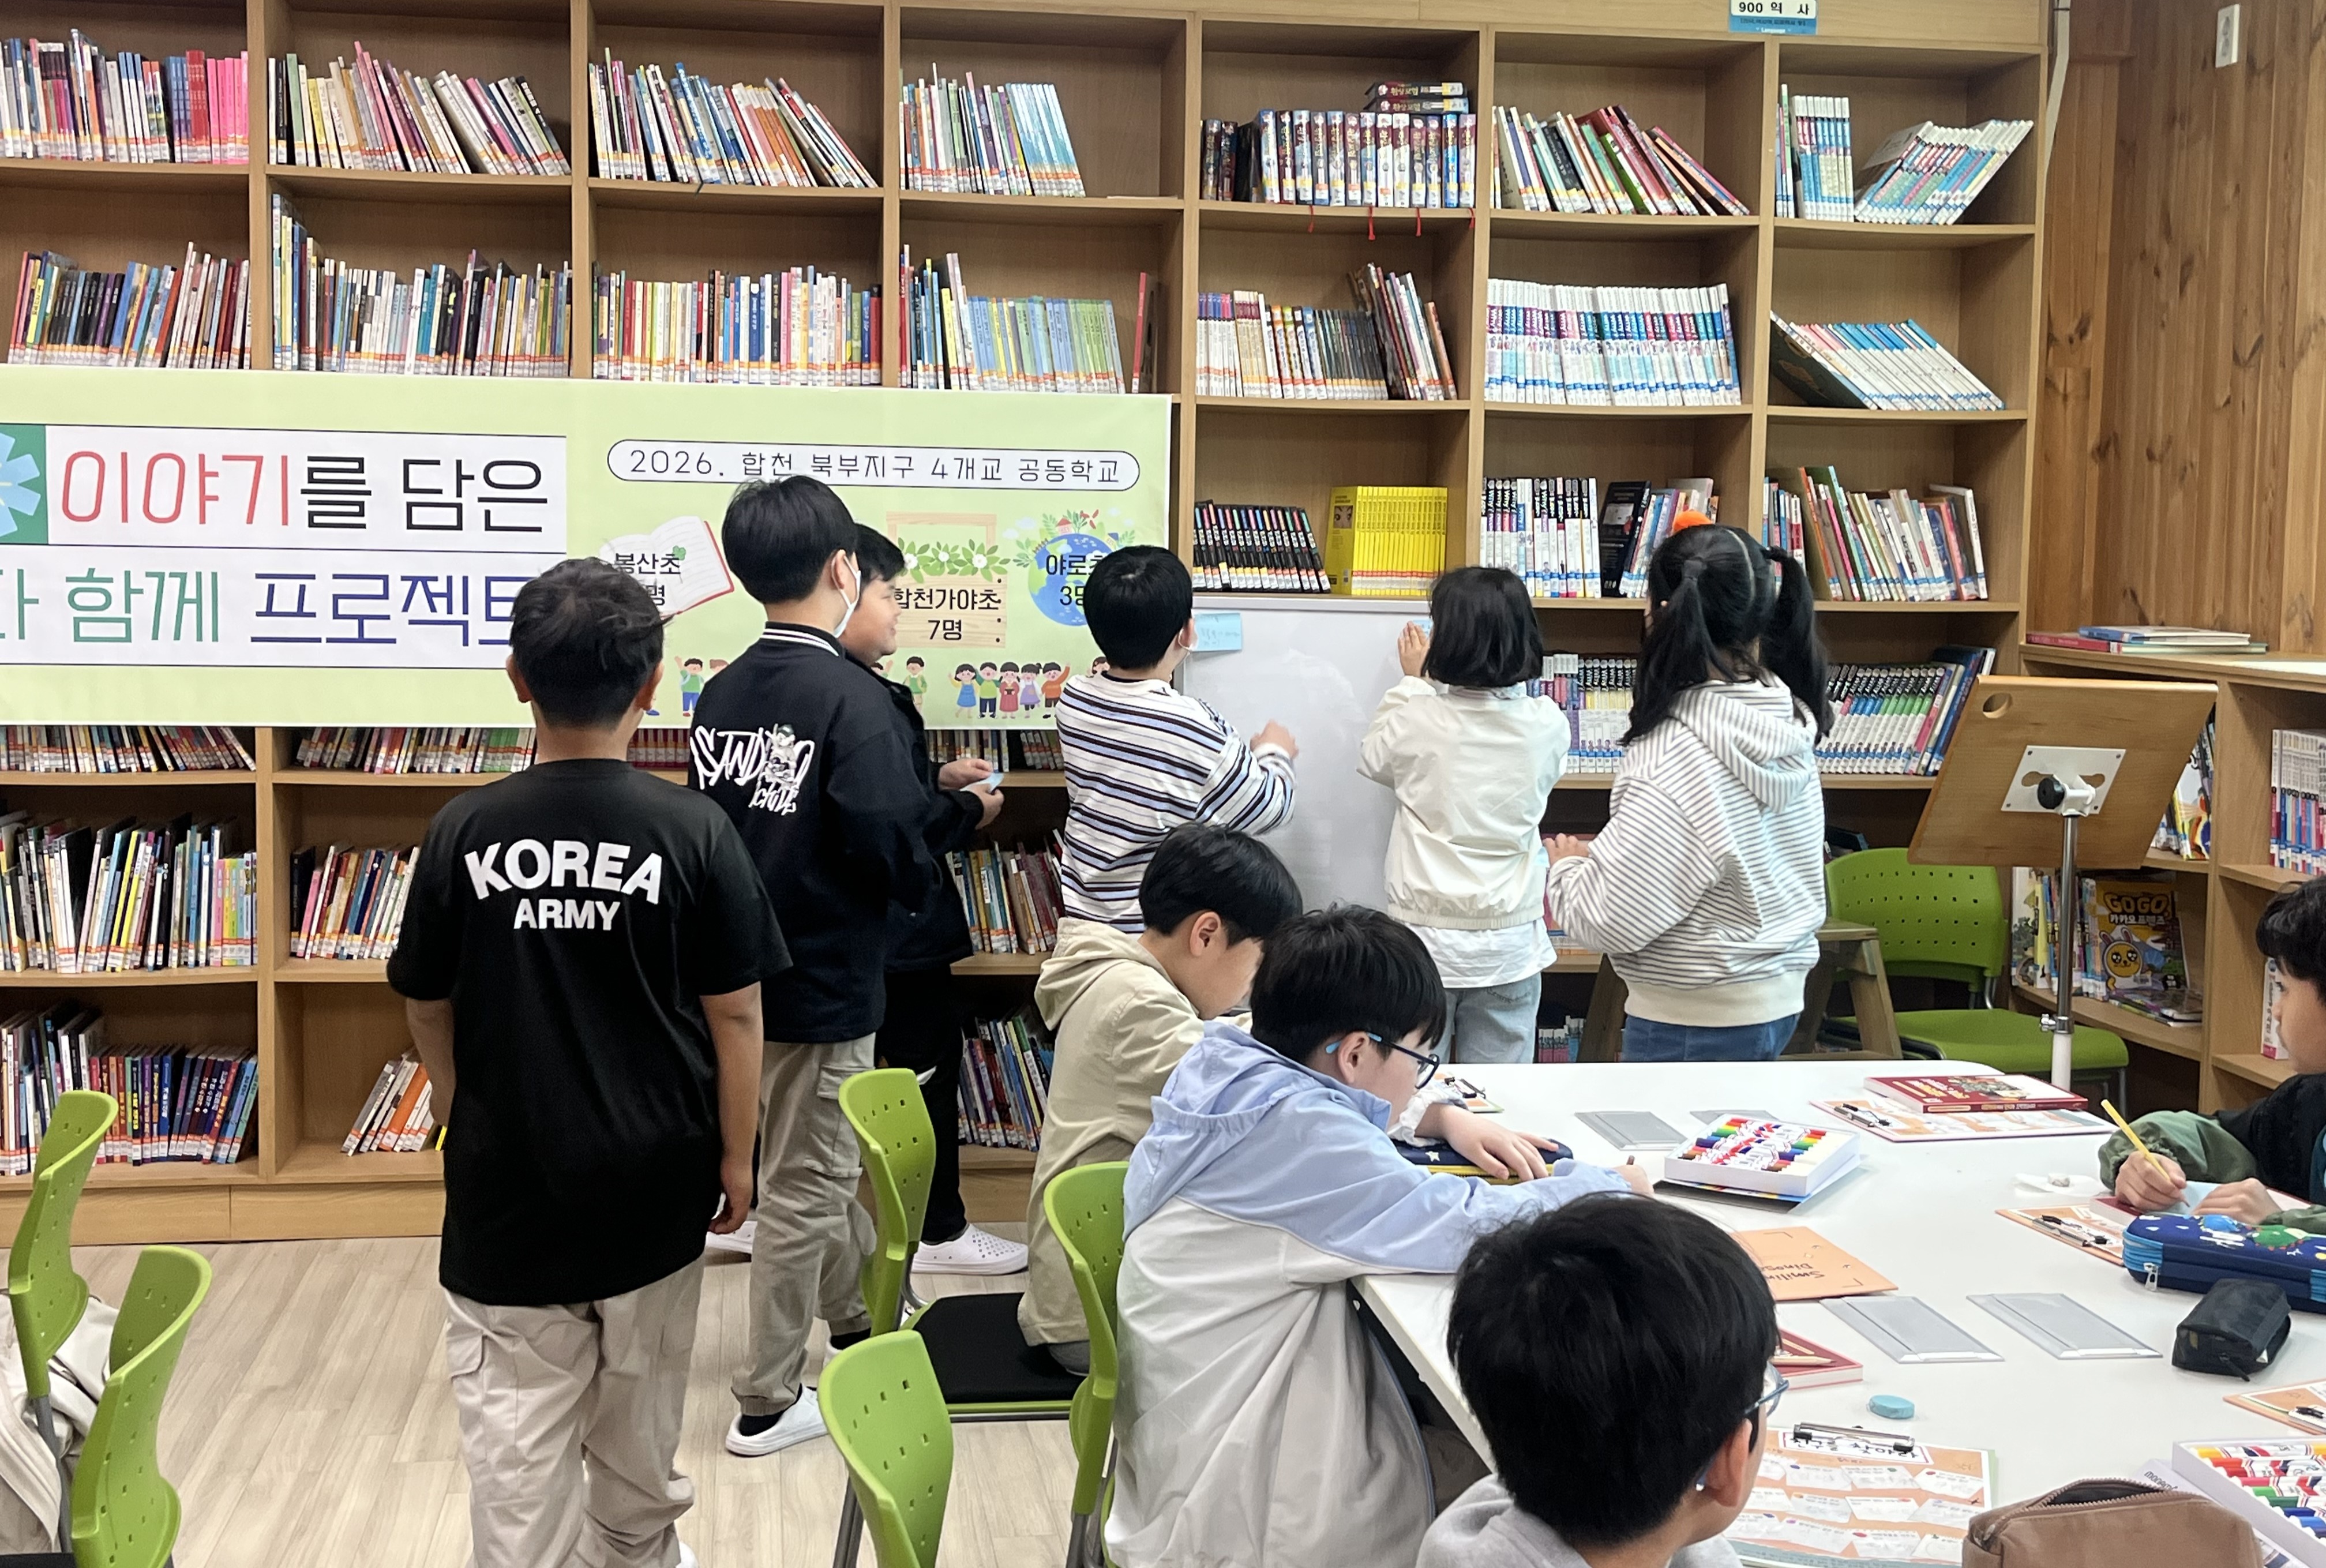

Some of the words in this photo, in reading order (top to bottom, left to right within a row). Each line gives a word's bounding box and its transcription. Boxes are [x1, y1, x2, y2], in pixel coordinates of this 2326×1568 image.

[1739, 2, 1763, 13] 900
[631, 450, 724, 476] 2026.
[742, 452, 792, 476] 합천
[811, 454, 914, 478] 북부지구
[931, 457, 1002, 480] 4개교
[1019, 459, 1119, 482] 공동학교
[61, 451, 372, 529] 이야기를
[402, 459, 548, 532] 담은
[614, 553, 681, 575] 봉산초
[65, 567, 219, 643] 함께
[894, 588, 999, 610] 합천가야초
[928, 619, 962, 641] 7명
[464, 838, 662, 905] KOREA
[513, 898, 621, 931] ARMY
[1766, 1270, 1825, 1280] Smilin
